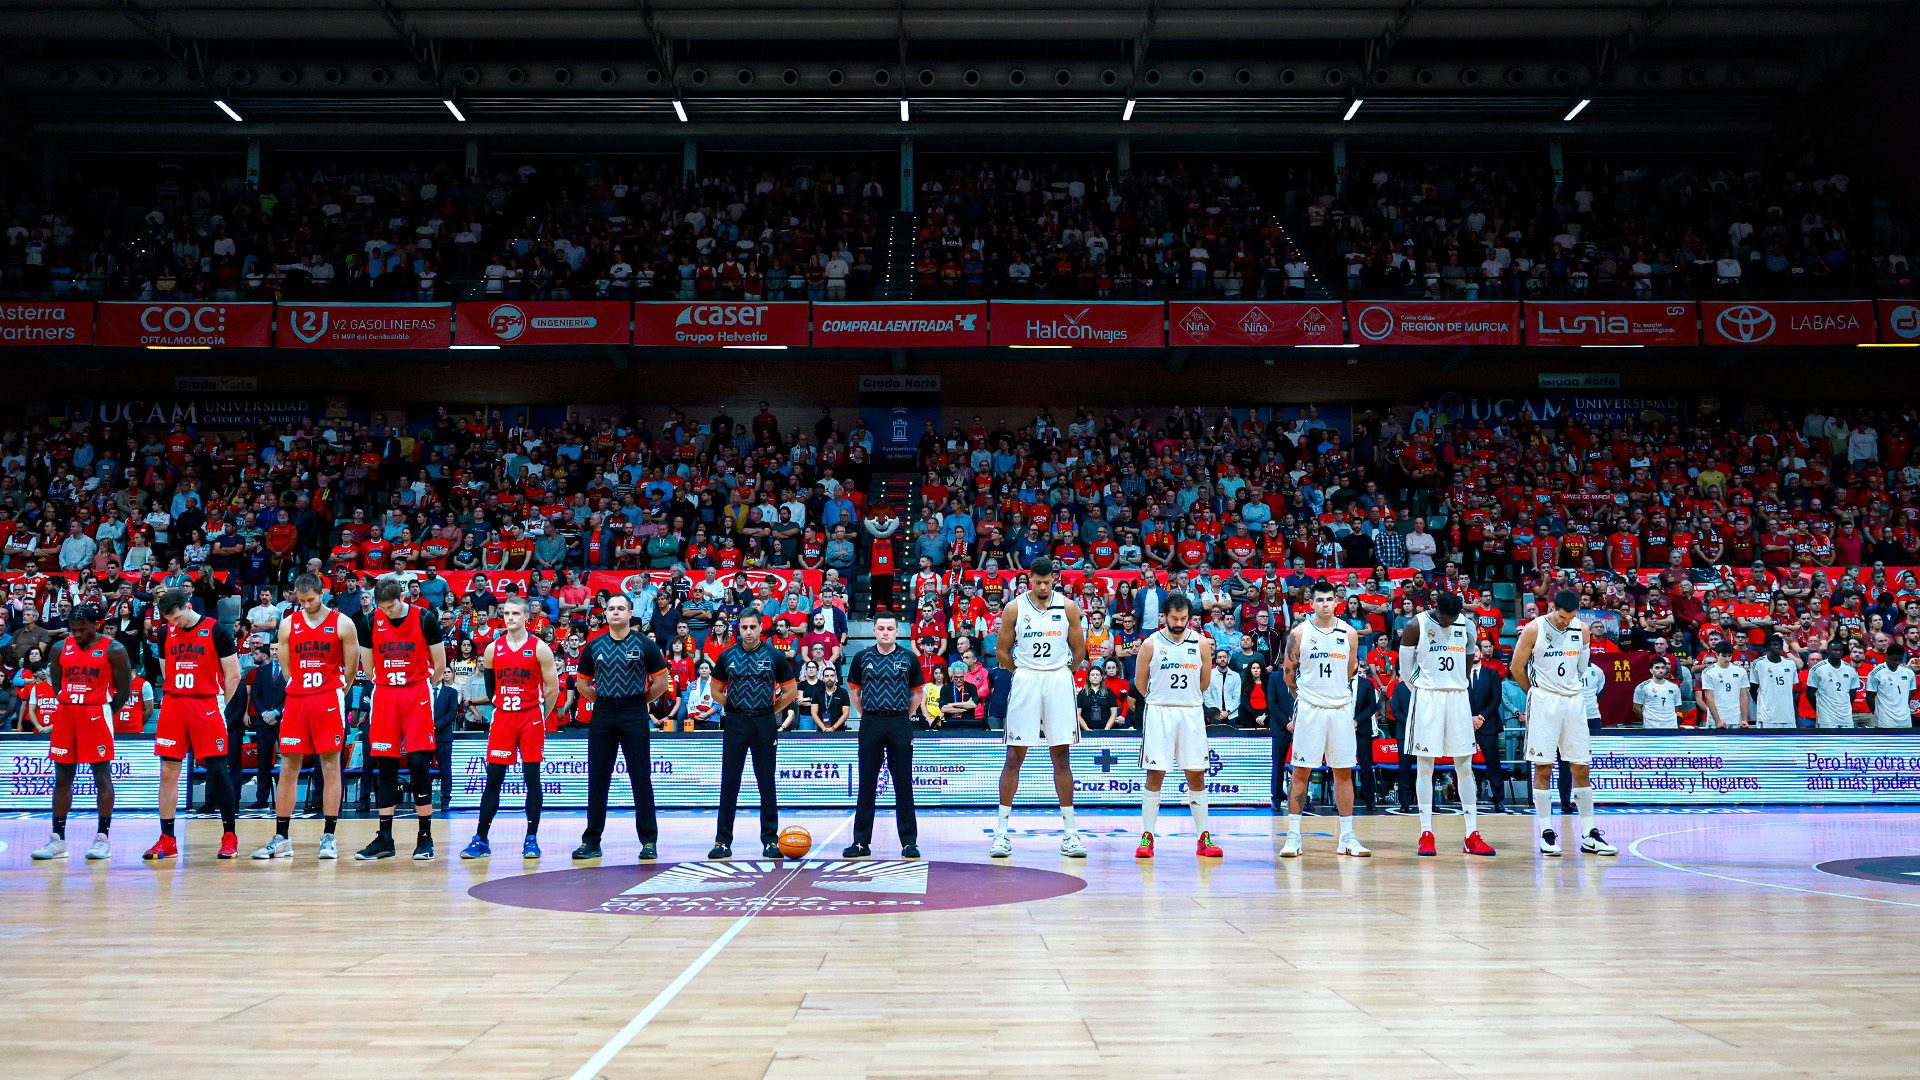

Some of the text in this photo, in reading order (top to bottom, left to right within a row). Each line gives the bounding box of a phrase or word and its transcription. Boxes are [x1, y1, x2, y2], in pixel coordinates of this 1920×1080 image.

[333, 319, 436, 330] V2 GASOLINERAS
[822, 319, 954, 332] COMPRALAENTRADA
[1401, 320, 1508, 332] REGIÓN DE MURCIA
[1791, 315, 1860, 330] LABASA
[675, 330, 768, 344] Grupo Helvetia
[1022, 629, 1062, 640] AUTOHERO
[170, 643, 206, 656] UCAM
[295, 640, 332, 655] UCAM
[379, 641, 416, 655] UCAM
[1032, 642, 1051, 658] 22
[1428, 645, 1466, 653] AUTOHERO
[1309, 652, 1347, 660] AUTOHERO
[1160, 663, 1198, 672] AUTOHERO
[1319, 662, 1332, 678] 14
[1438, 656, 1455, 672] 30
[1557, 662, 1566, 677] 6
[64, 665, 101, 680] UCAM
[386, 671, 407, 686] 35
[497, 666, 531, 680] UCAM
[175, 673, 194, 689] 00
[303, 672, 323, 688] 20
[1170, 673, 1188, 689] 23
[1774, 676, 1785, 686] 15
[1835, 682, 1842, 692] 2
[502, 695, 522, 711] 22
[44, 714, 51, 724] 6
[120, 711, 131, 721] 12
[1656, 752, 1723, 770] corriente
[1806, 752, 1841, 770] Pero
[1844, 752, 1871, 774] hay
[1874, 755, 1905, 770] otra
[1074, 780, 1141, 794] Cruz Roja
[1592, 770, 1762, 794] struido vidas y hogares.
[1807, 772, 1834, 790] aún
[1838, 772, 1868, 790] más
